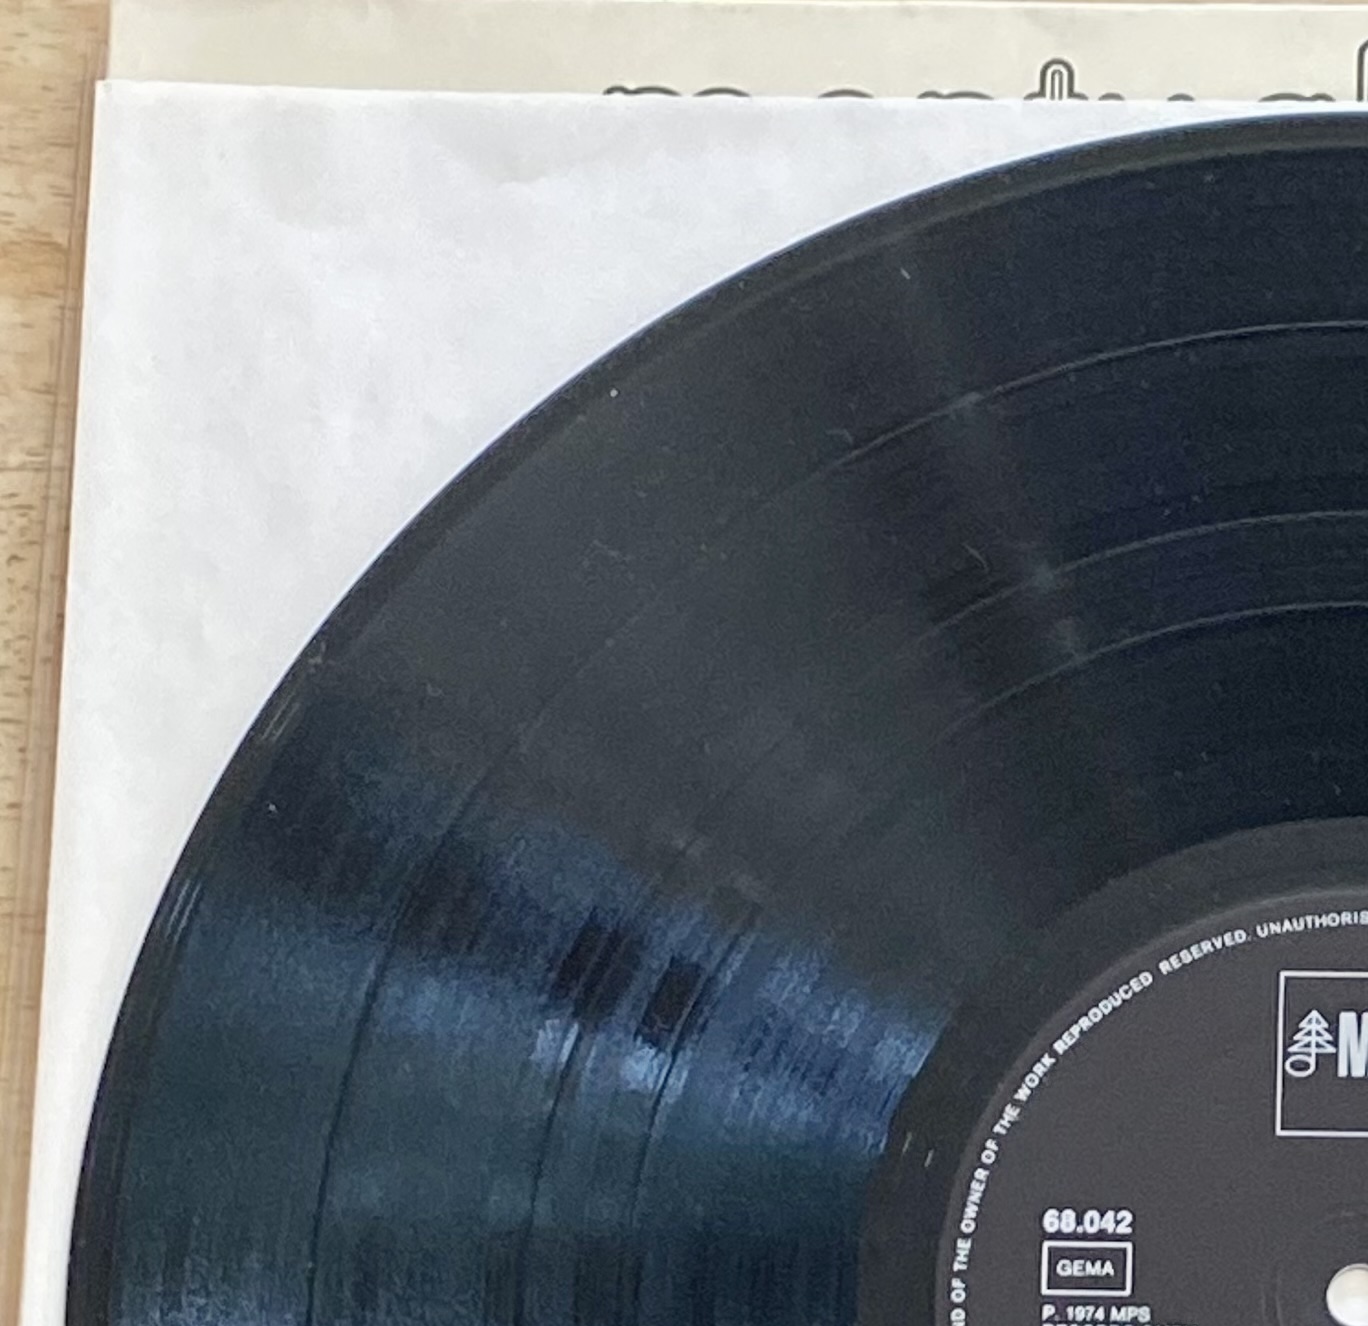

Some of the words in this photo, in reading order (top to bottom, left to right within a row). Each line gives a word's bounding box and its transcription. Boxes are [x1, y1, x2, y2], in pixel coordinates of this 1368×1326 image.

[1052, 971, 1153, 1055] REPRODUCED
[1013, 1053, 1056, 1102] WORK
[992, 1103, 1021, 1135] THE
[980, 1138, 999, 1165] OF
[960, 1167, 990, 1234] OWNER
[1042, 1209, 1134, 1235] 68.042
[952, 1237, 972, 1272] THE
[1055, 1259, 1116, 1278] GEMA
[950, 1278, 966, 1304] OF
[1066, 1305, 1106, 1322] 1974
[1109, 1305, 1151, 1323] MPS
